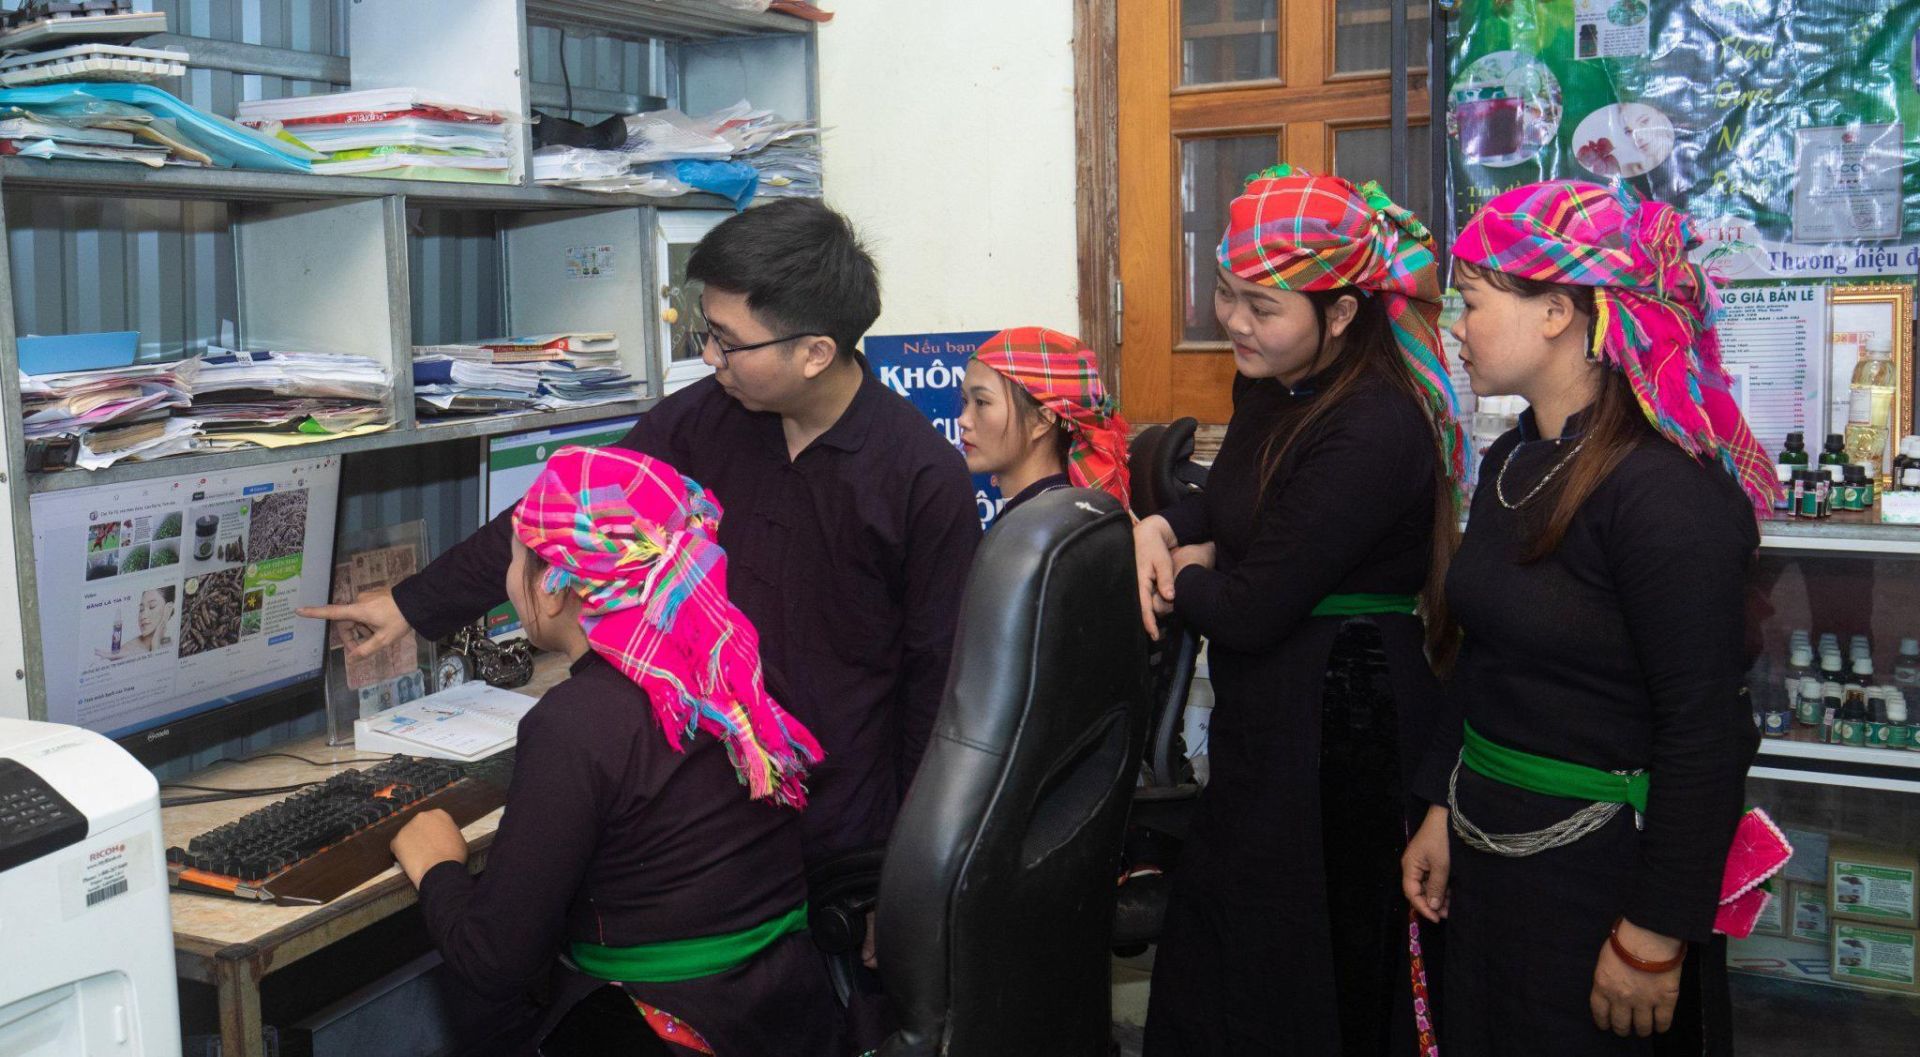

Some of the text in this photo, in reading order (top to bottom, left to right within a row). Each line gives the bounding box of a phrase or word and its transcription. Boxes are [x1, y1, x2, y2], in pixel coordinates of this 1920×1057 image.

[1855, 244, 1898, 273] hiệu
[1906, 246, 1919, 267] đ
[1718, 292, 1737, 304] NG
[1740, 289, 1765, 304] GIÁ
[903, 339, 976, 355] Nếu bạn
[880, 358, 967, 397] KHÔN
[932, 417, 962, 445] CU
[89, 844, 119, 861] RICOH
